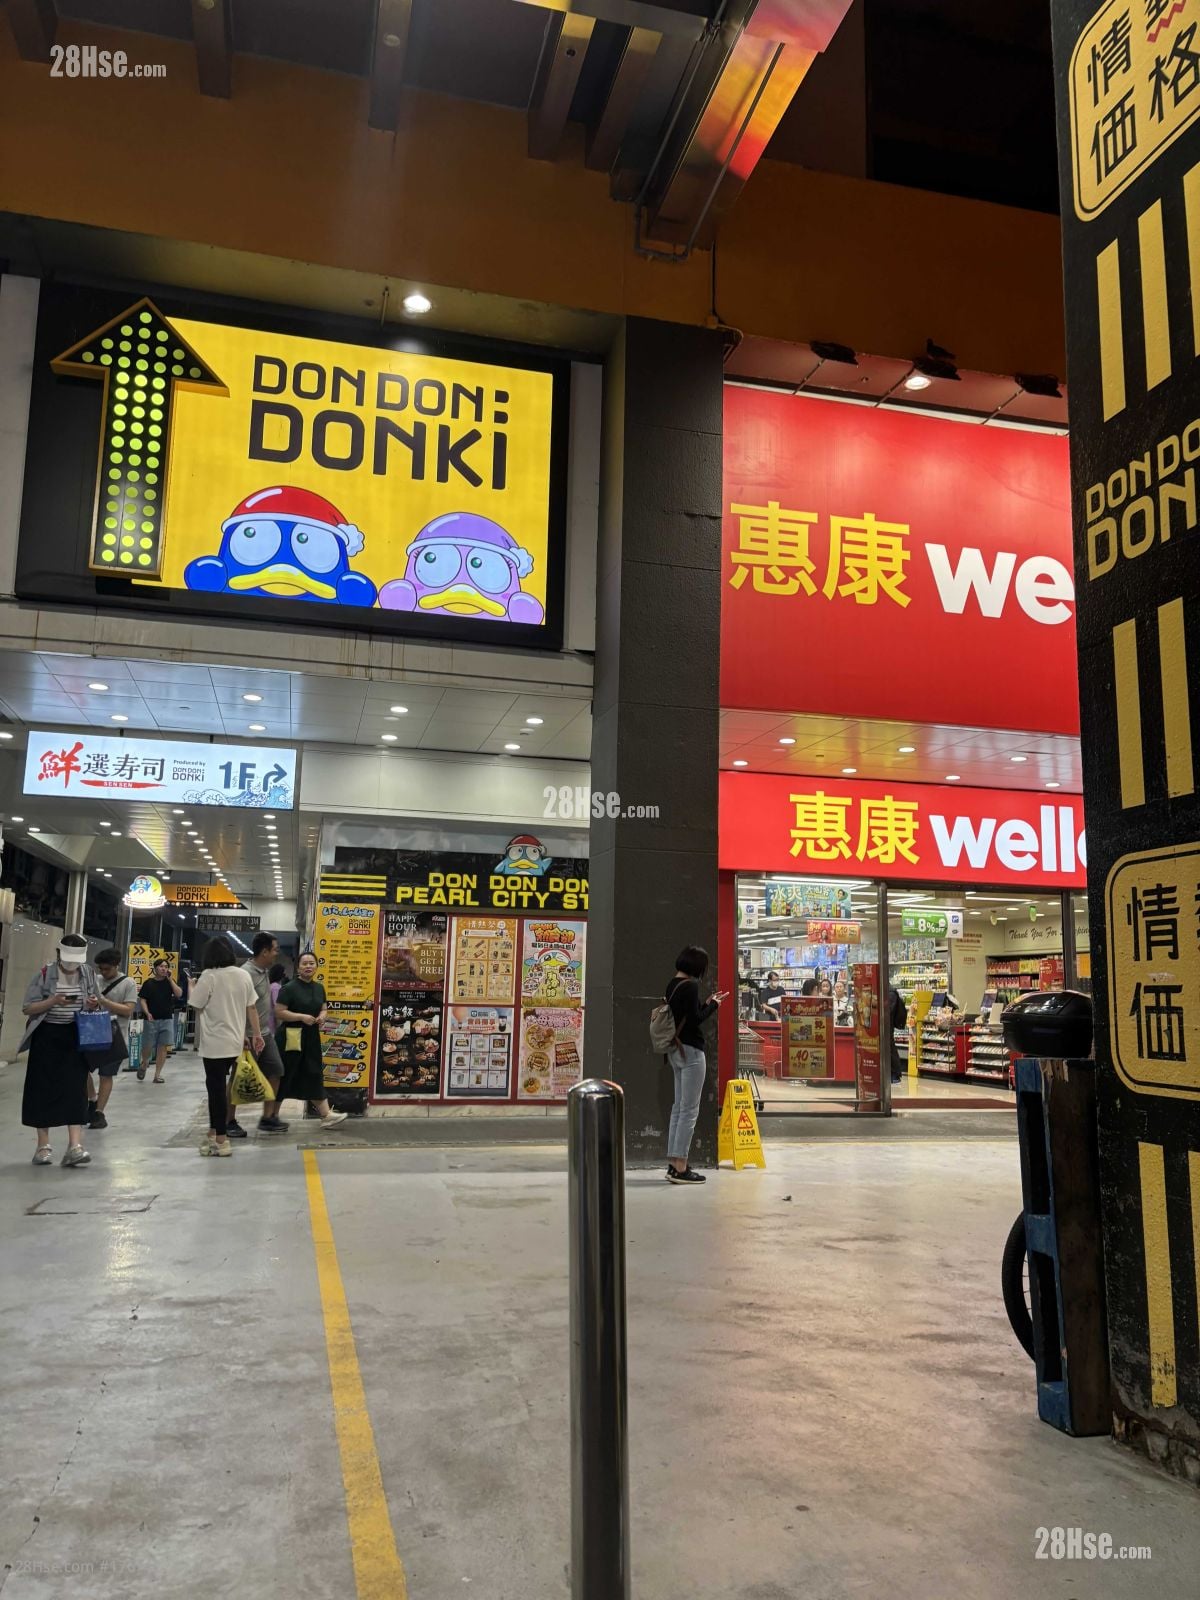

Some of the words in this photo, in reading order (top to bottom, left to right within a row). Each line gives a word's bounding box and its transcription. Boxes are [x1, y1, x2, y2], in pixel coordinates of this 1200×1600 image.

[253, 355, 366, 406] DON
[1086, 451, 1151, 523] DON
[729, 501, 912, 608] 惠康
[219, 761, 256, 790] 1F
[789, 791, 920, 864] 惠康
[929, 805, 1088, 873] well
[429, 873, 477, 889] DON
[489, 875, 537, 891] DON
[396, 887, 479, 906] PEARL
[492, 891, 550, 908] CITY
[388, 915, 417, 923] HAPPY
[388, 923, 417, 931] HOUR
[1009, 929, 1028, 940] Thank
[1031, 928, 1043, 940] You
[1046, 926, 1057, 937] For
[420, 949, 437, 957] BUY
[420, 966, 444, 975] FREE
